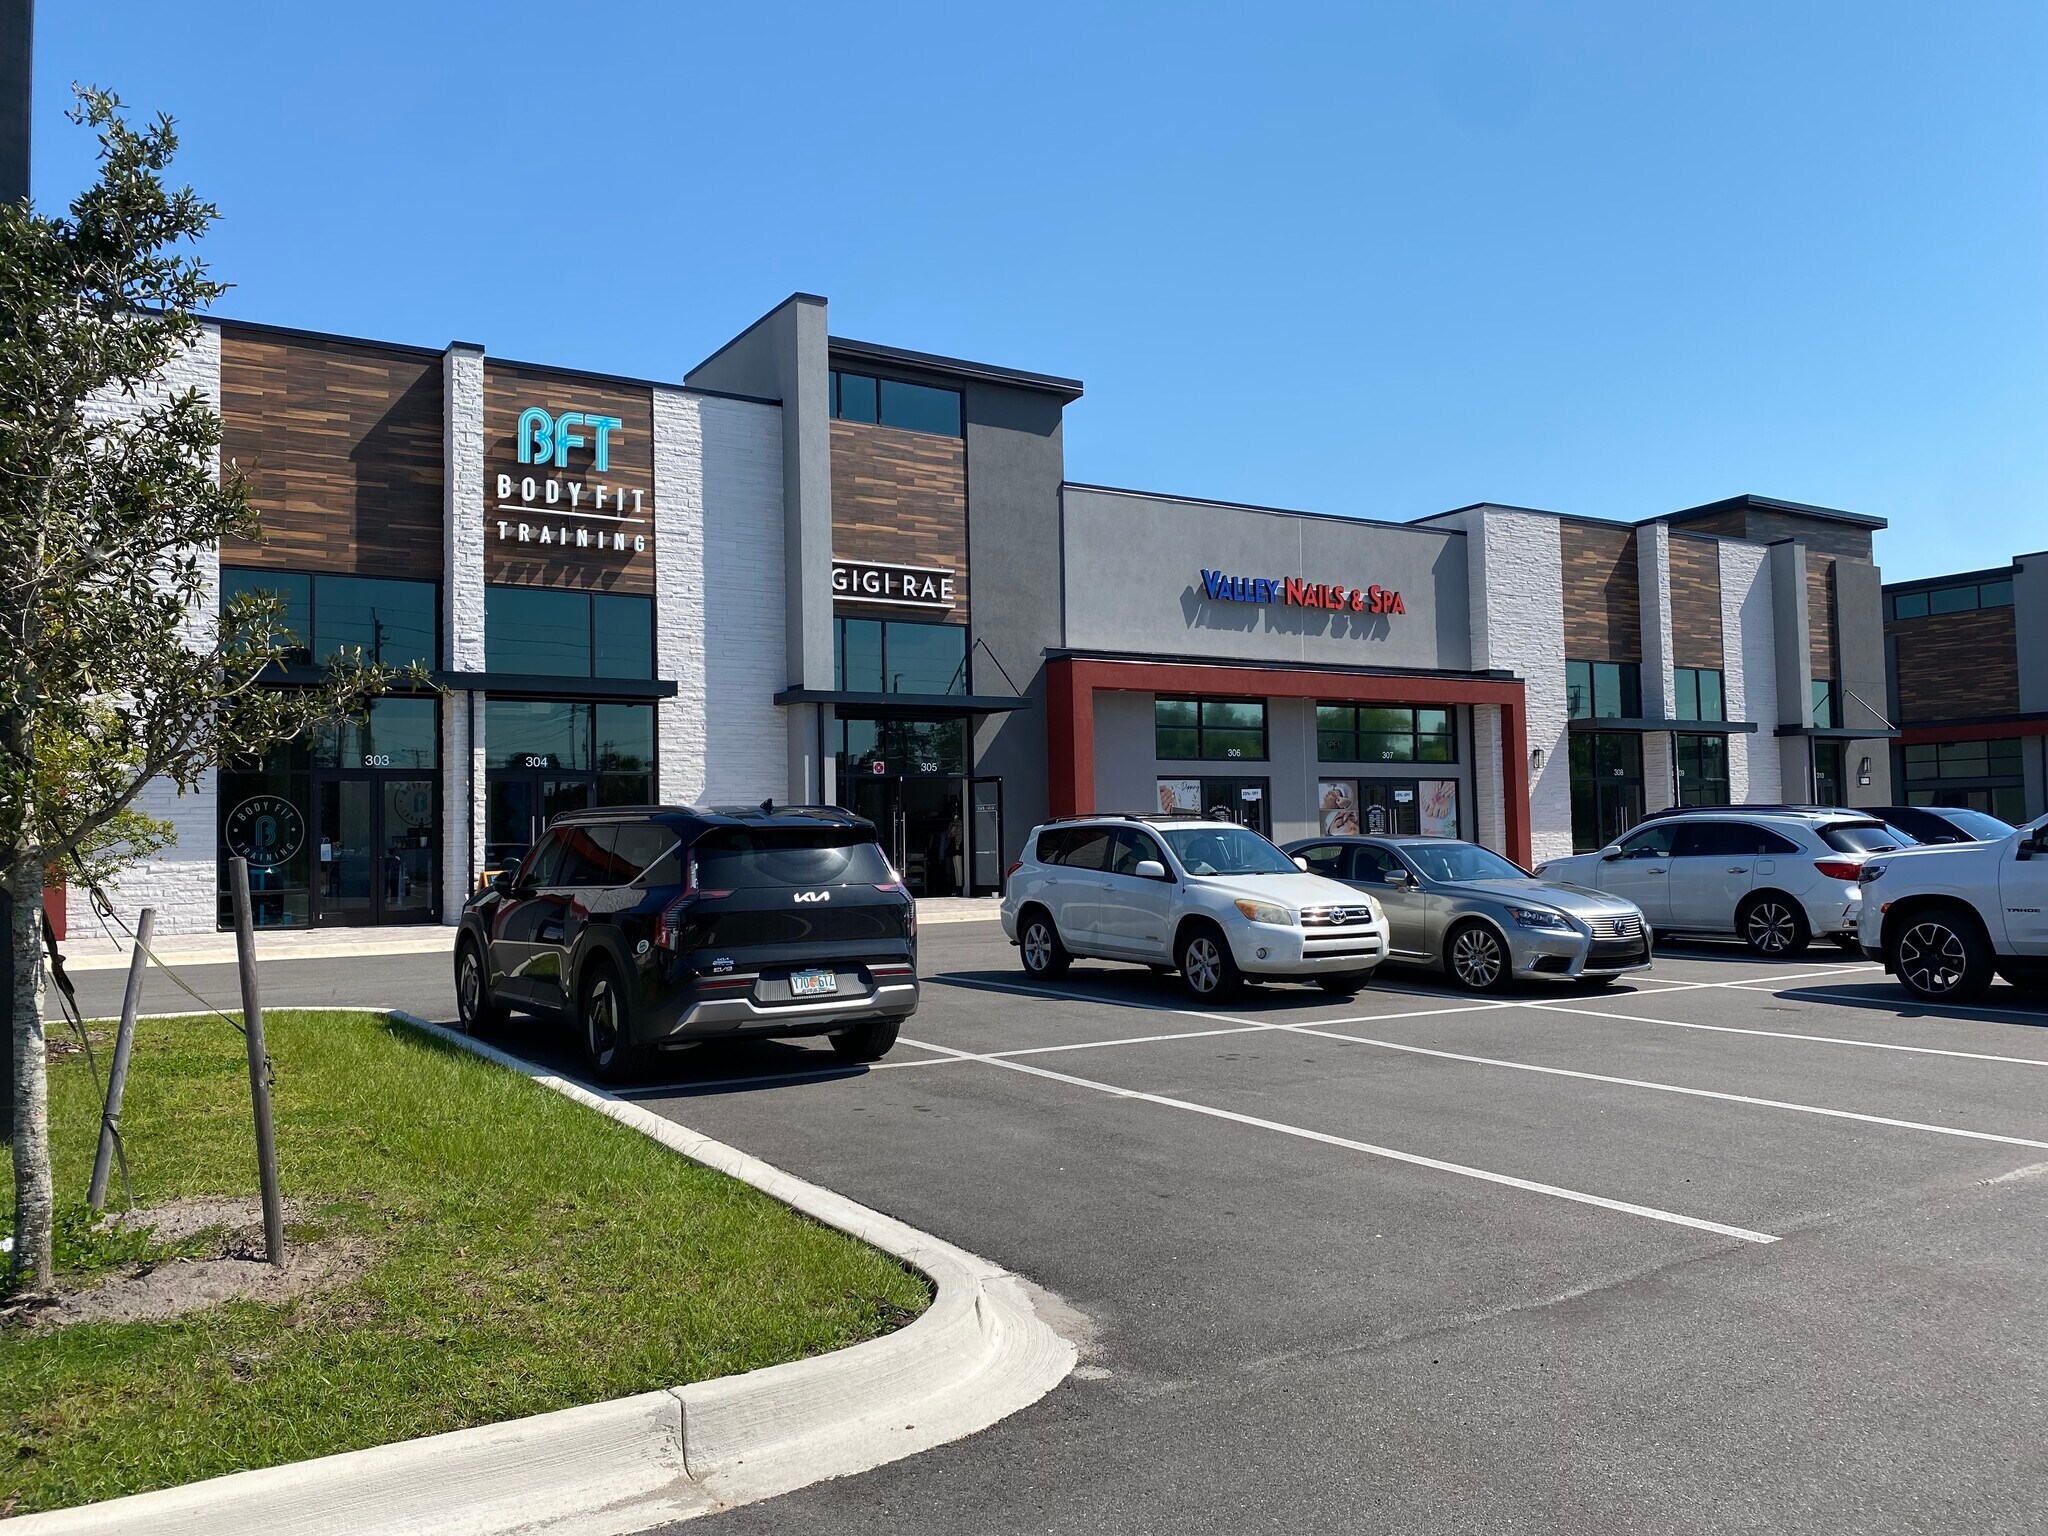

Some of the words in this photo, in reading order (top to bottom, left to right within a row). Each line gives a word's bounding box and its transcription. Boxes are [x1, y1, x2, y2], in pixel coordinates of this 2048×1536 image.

[517, 406, 622, 472] BFT
[497, 474, 582, 507] BODY
[595, 485, 645, 513] FIT
[497, 521, 645, 553] TRAINING
[832, 568, 890, 594] GIGI
[903, 574, 954, 600] RAE
[1350, 589, 1364, 612] &
[365, 754, 390, 766] 303
[525, 756, 548, 768] 304
[1227, 748, 1241, 757] 306
[1381, 751, 1394, 759] 307
[920, 762, 938, 773] 305
[237, 801, 268, 821] BODY
[274, 803, 294, 819] FIT
[237, 842, 294, 861] TRAINING
